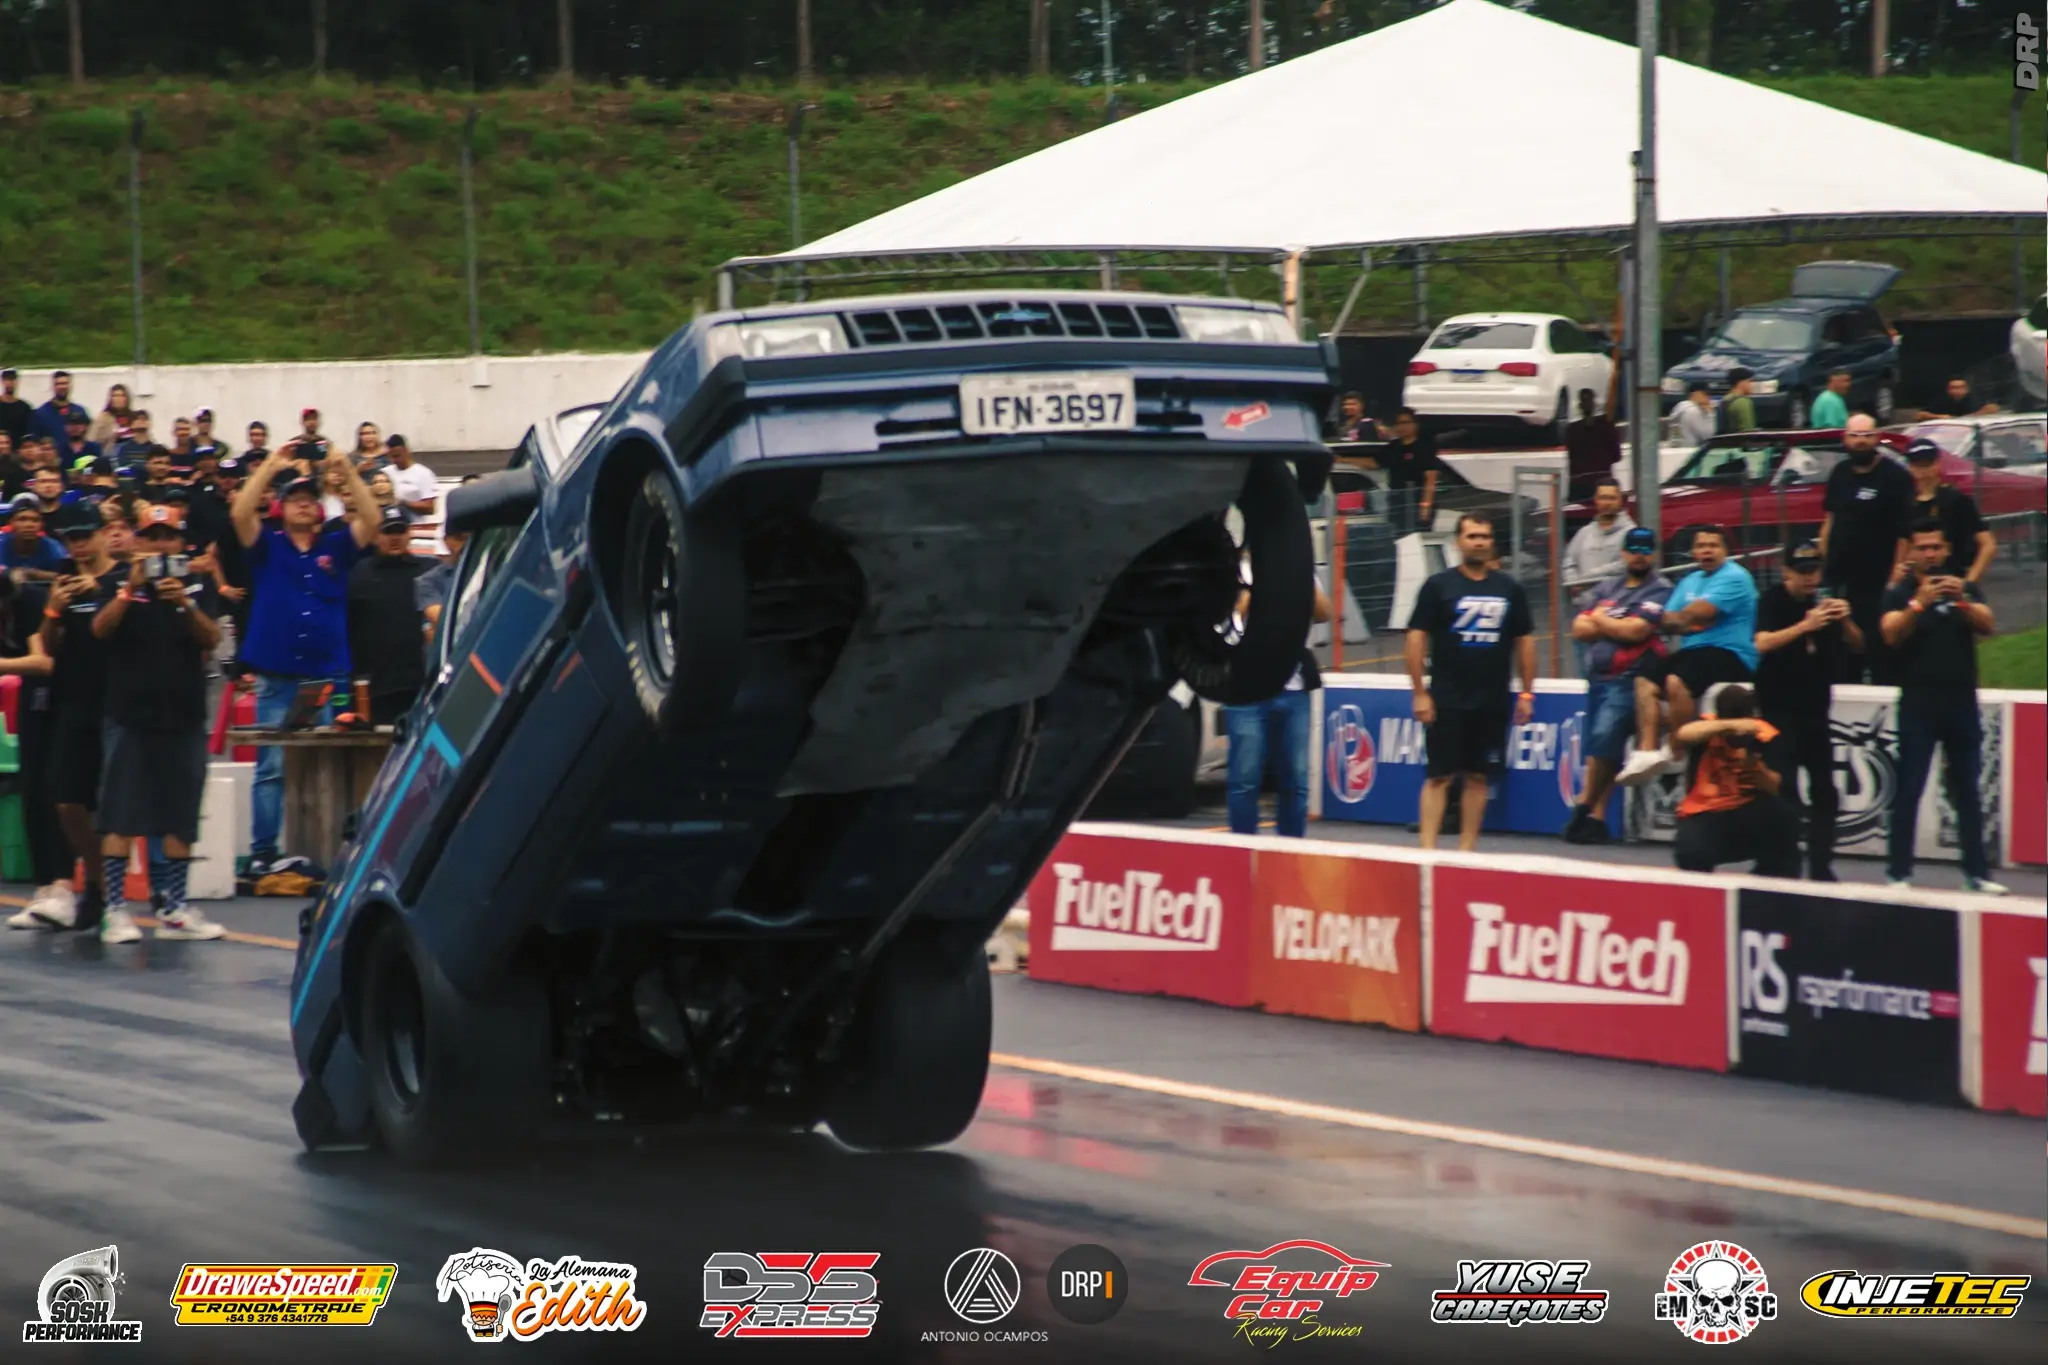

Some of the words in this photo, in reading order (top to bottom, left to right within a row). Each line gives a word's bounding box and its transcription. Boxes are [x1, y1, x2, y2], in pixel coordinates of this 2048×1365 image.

[1453, 596, 1508, 629] 79
[1052, 862, 1223, 950] FuelTech
[1272, 904, 1401, 974] VELOPARK
[1466, 902, 1690, 1004] FuelTech
[1741, 929, 1789, 1014] RS
